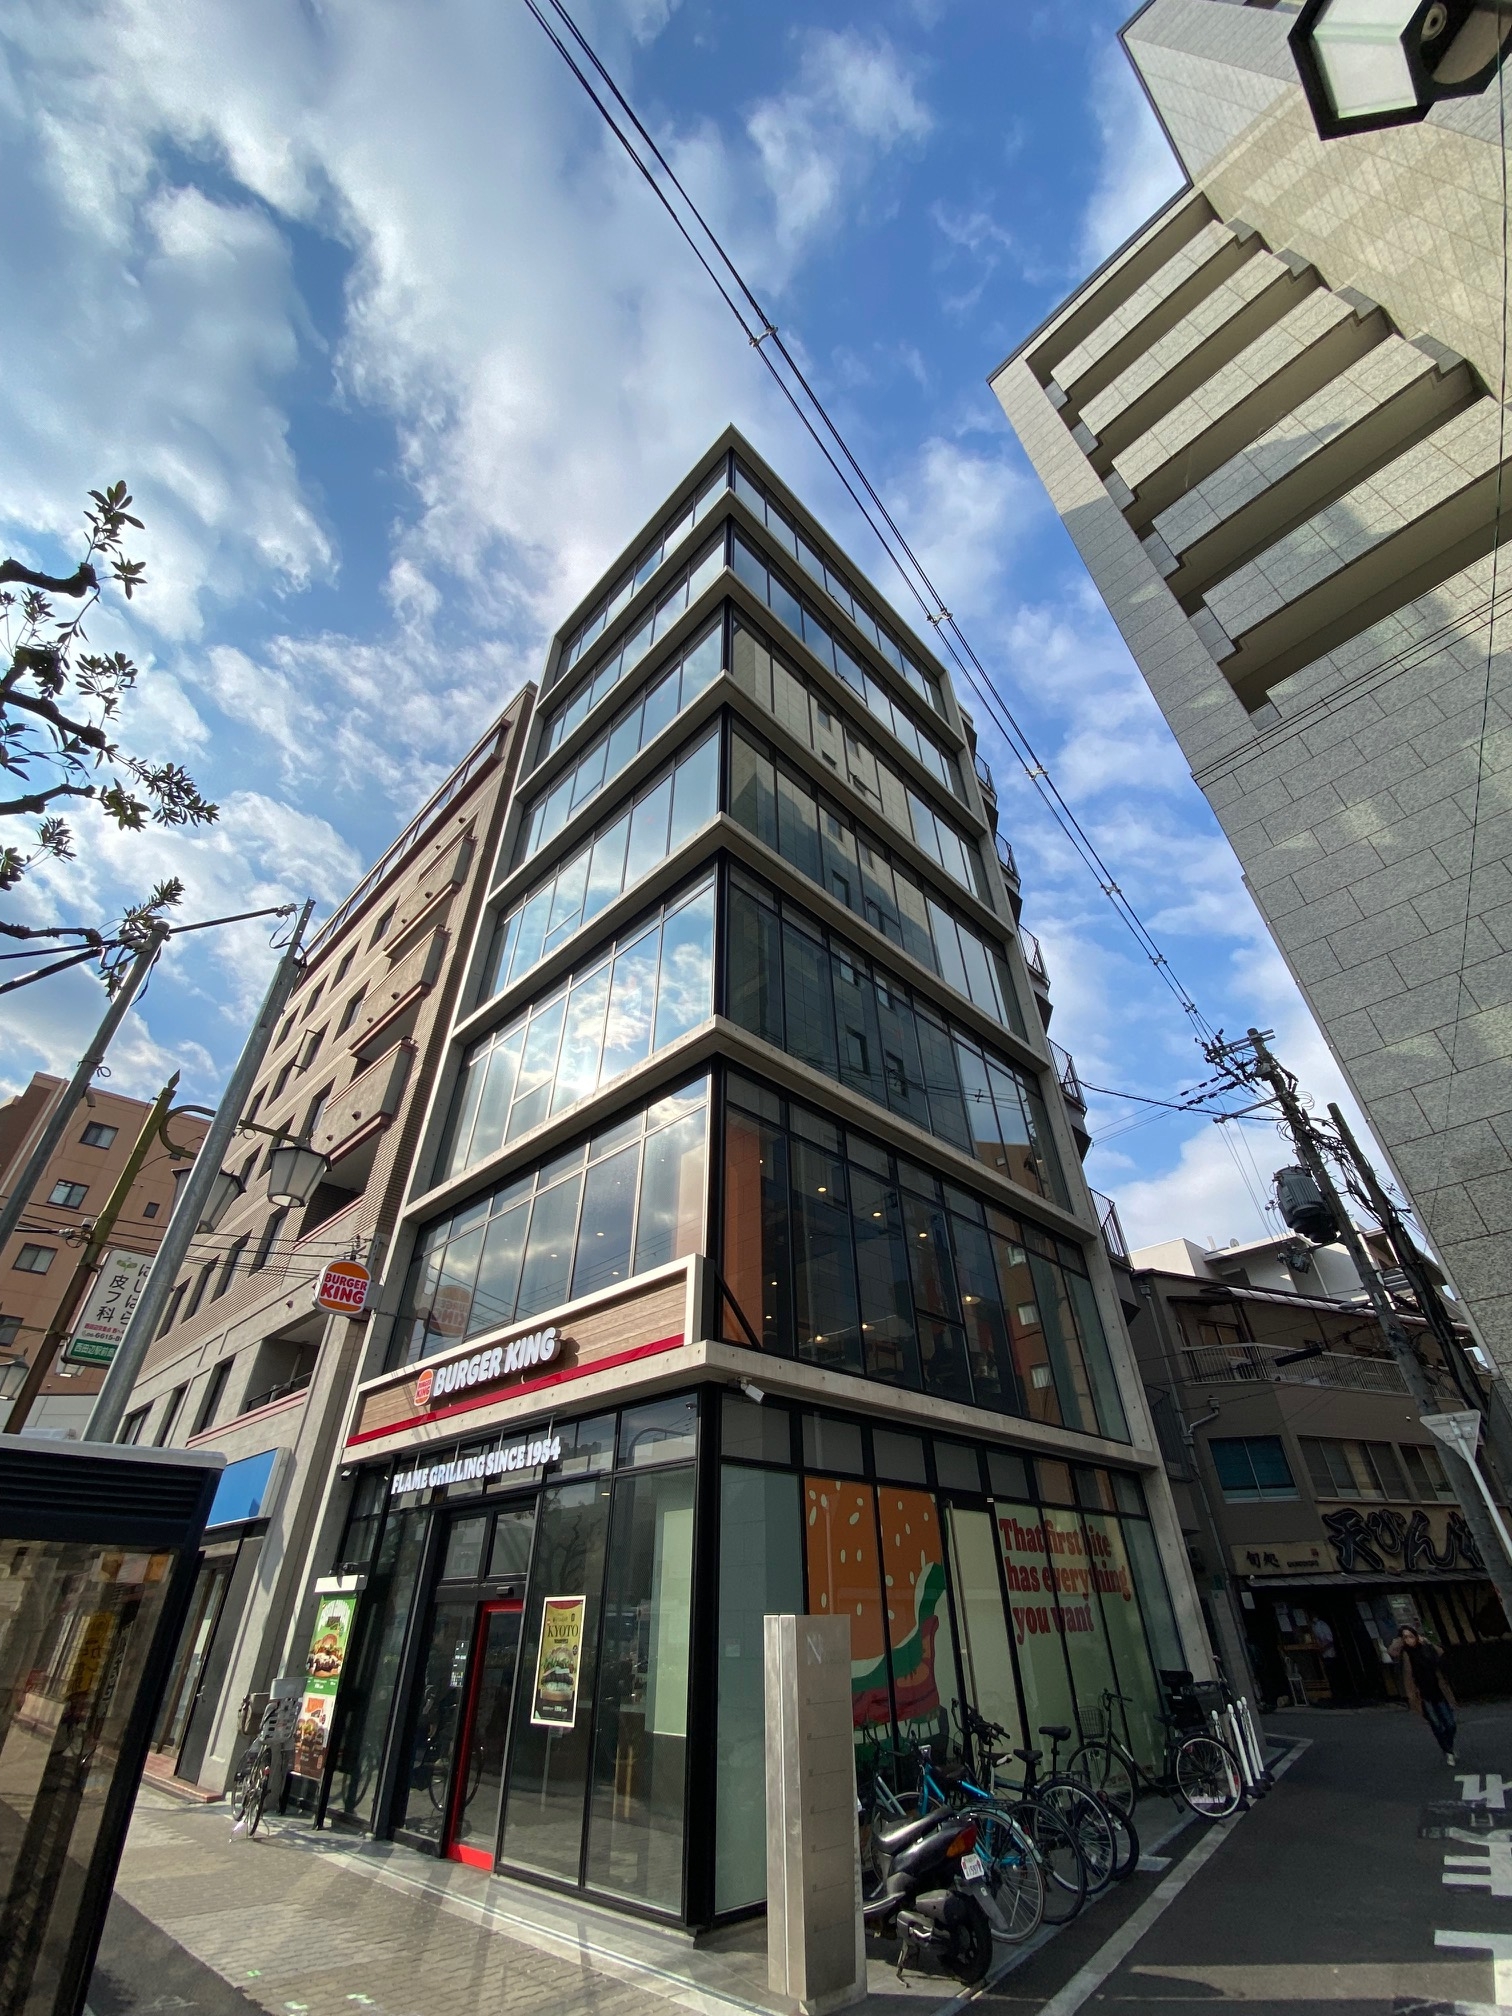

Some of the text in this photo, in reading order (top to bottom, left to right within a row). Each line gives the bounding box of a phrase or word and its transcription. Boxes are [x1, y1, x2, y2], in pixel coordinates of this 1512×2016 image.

[97, 1274, 129, 1323] 皮フ科
[320, 1283, 365, 1304] KING
[325, 1272, 367, 1291] BURGER
[433, 1326, 556, 1397] BURGER KING
[391, 1436, 561, 1494] FLAME GRILLING SINCE 1954
[999, 1518, 1044, 1553] That
[1044, 1519, 1083, 1556] first
[1004, 1556, 1041, 1592] has
[547, 1623, 579, 1637] KYOTO
[1012, 1603, 1095, 1645] you want
